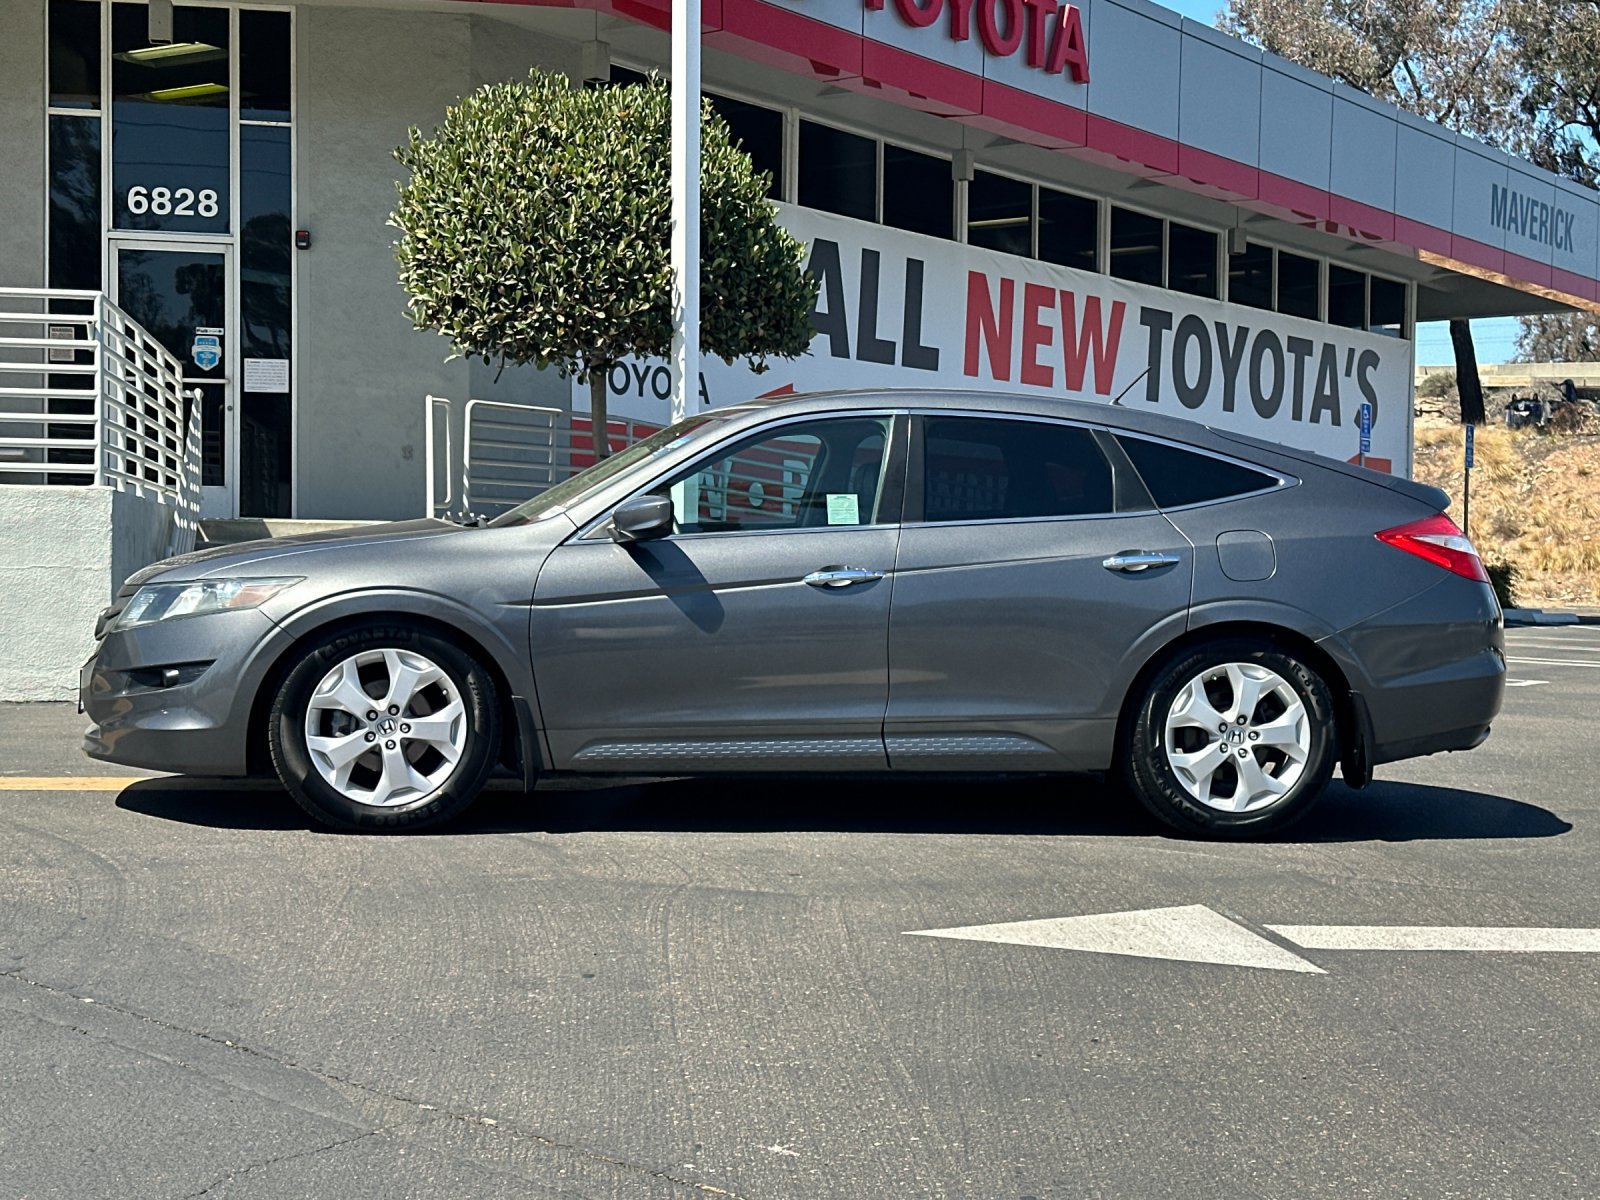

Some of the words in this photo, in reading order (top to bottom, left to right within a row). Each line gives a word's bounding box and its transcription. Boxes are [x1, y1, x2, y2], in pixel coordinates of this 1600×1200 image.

[864, 0, 1090, 84] YOTA
[127, 185, 219, 218] 6828
[1490, 183, 1575, 253] MAVERICK
[805, 237, 940, 371] ALL
[963, 270, 1127, 396] NEW
[1139, 306, 1381, 431] TOYOTA'S
[607, 360, 711, 405] OYOA
